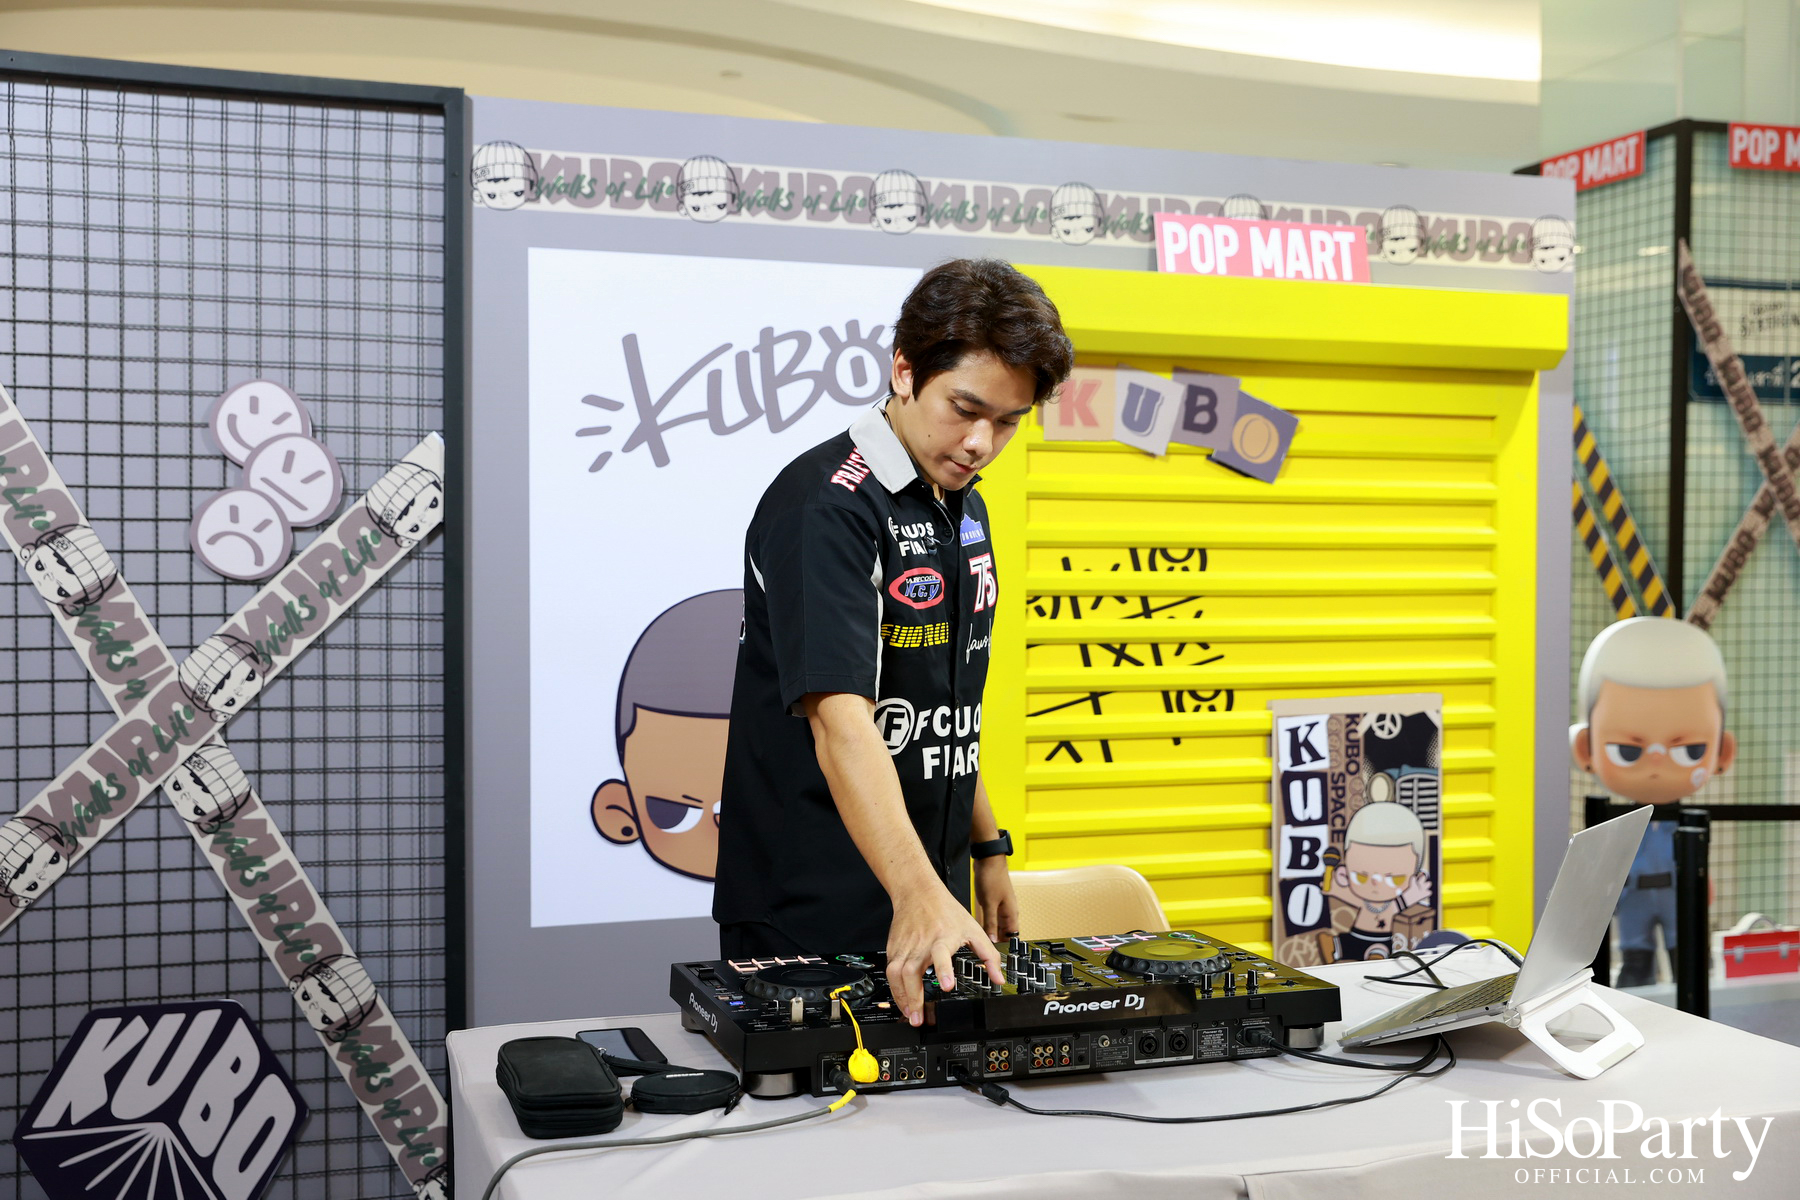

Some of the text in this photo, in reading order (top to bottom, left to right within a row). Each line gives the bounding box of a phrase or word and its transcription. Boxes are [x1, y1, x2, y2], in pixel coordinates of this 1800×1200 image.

[1582, 136, 1640, 185] MART
[1732, 127, 1780, 165] POP
[1162, 221, 1240, 275] POP
[1249, 226, 1356, 281] MART
[621, 322, 893, 468] KUBO
[1058, 378, 1280, 465] KUBO
[220, 506, 402, 680] KUBO
[968, 553, 997, 614] 75
[912, 702, 982, 742] FCUO
[1345, 713, 1361, 776] KUBO
[24, 681, 216, 864] KUBO
[1331, 772, 1347, 844] SPACE
[193, 792, 344, 986] KUBO
[688, 991, 712, 1021] Pioneer
[1043, 999, 1121, 1016] Pioneer
[31, 1008, 298, 1200] KUBO
